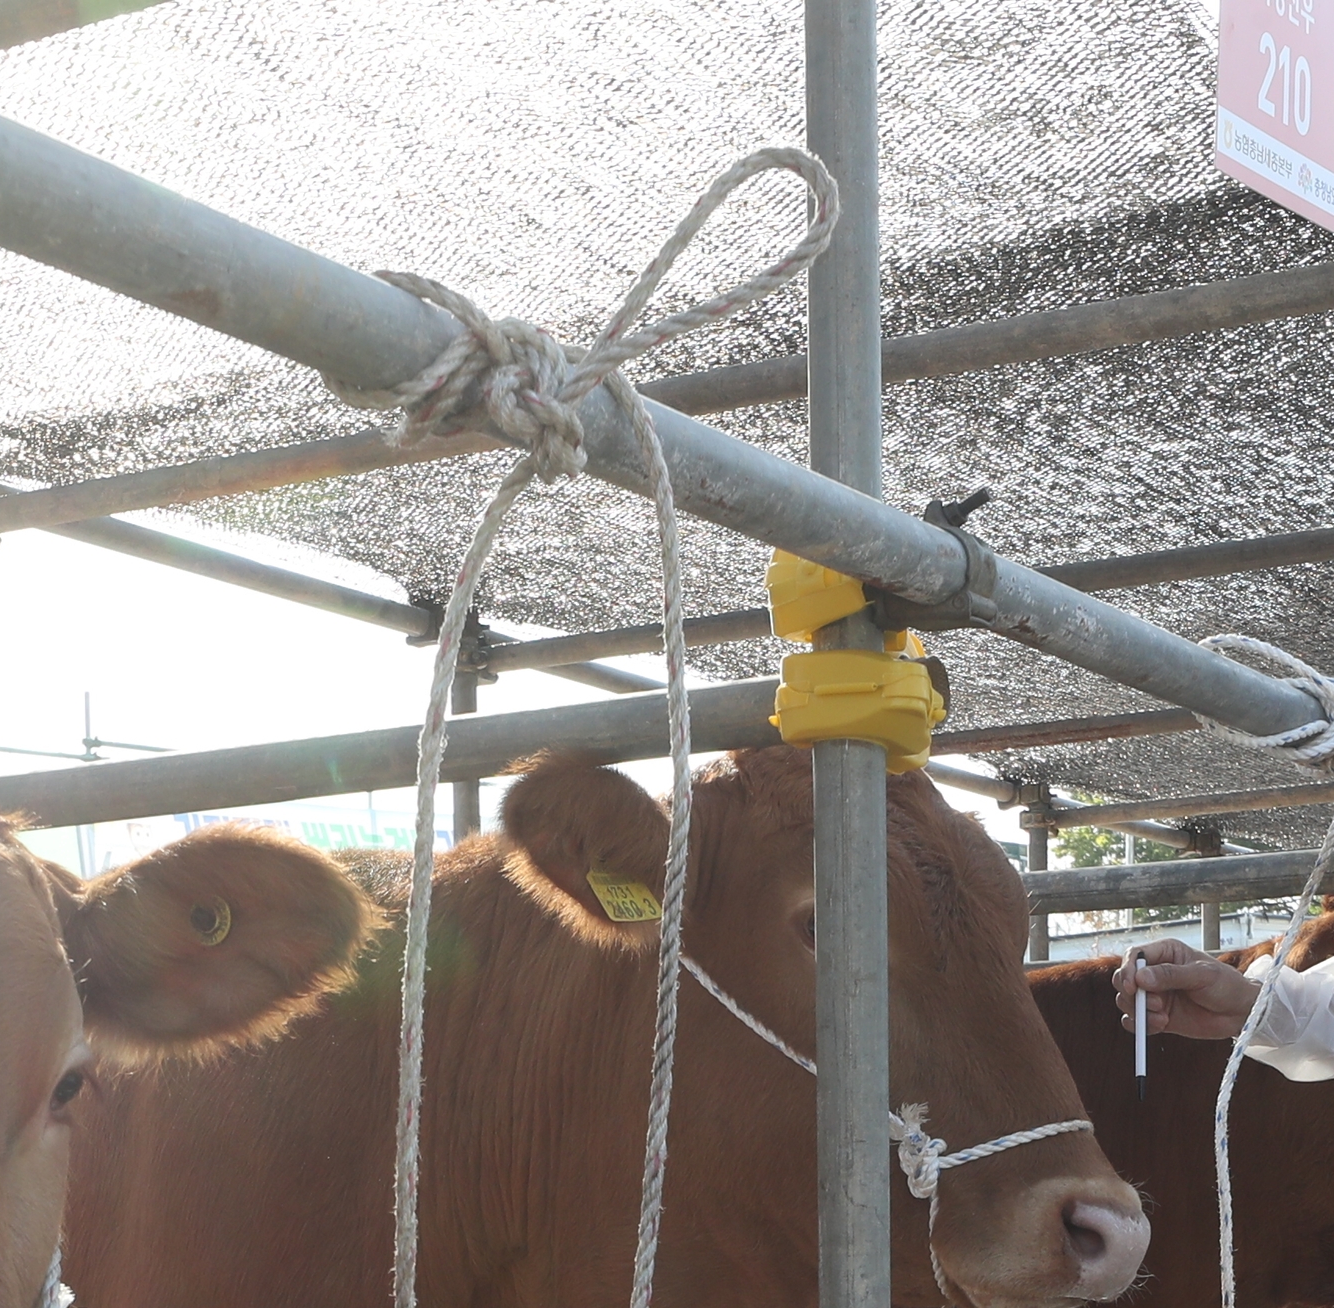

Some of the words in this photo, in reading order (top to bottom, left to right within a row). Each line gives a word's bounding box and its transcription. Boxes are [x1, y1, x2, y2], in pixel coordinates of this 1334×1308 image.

[1258, 31, 1311, 136] 210
[1234, 129, 1293, 180] 농협충남세종본부
[643, 898, 657, 915] 3
